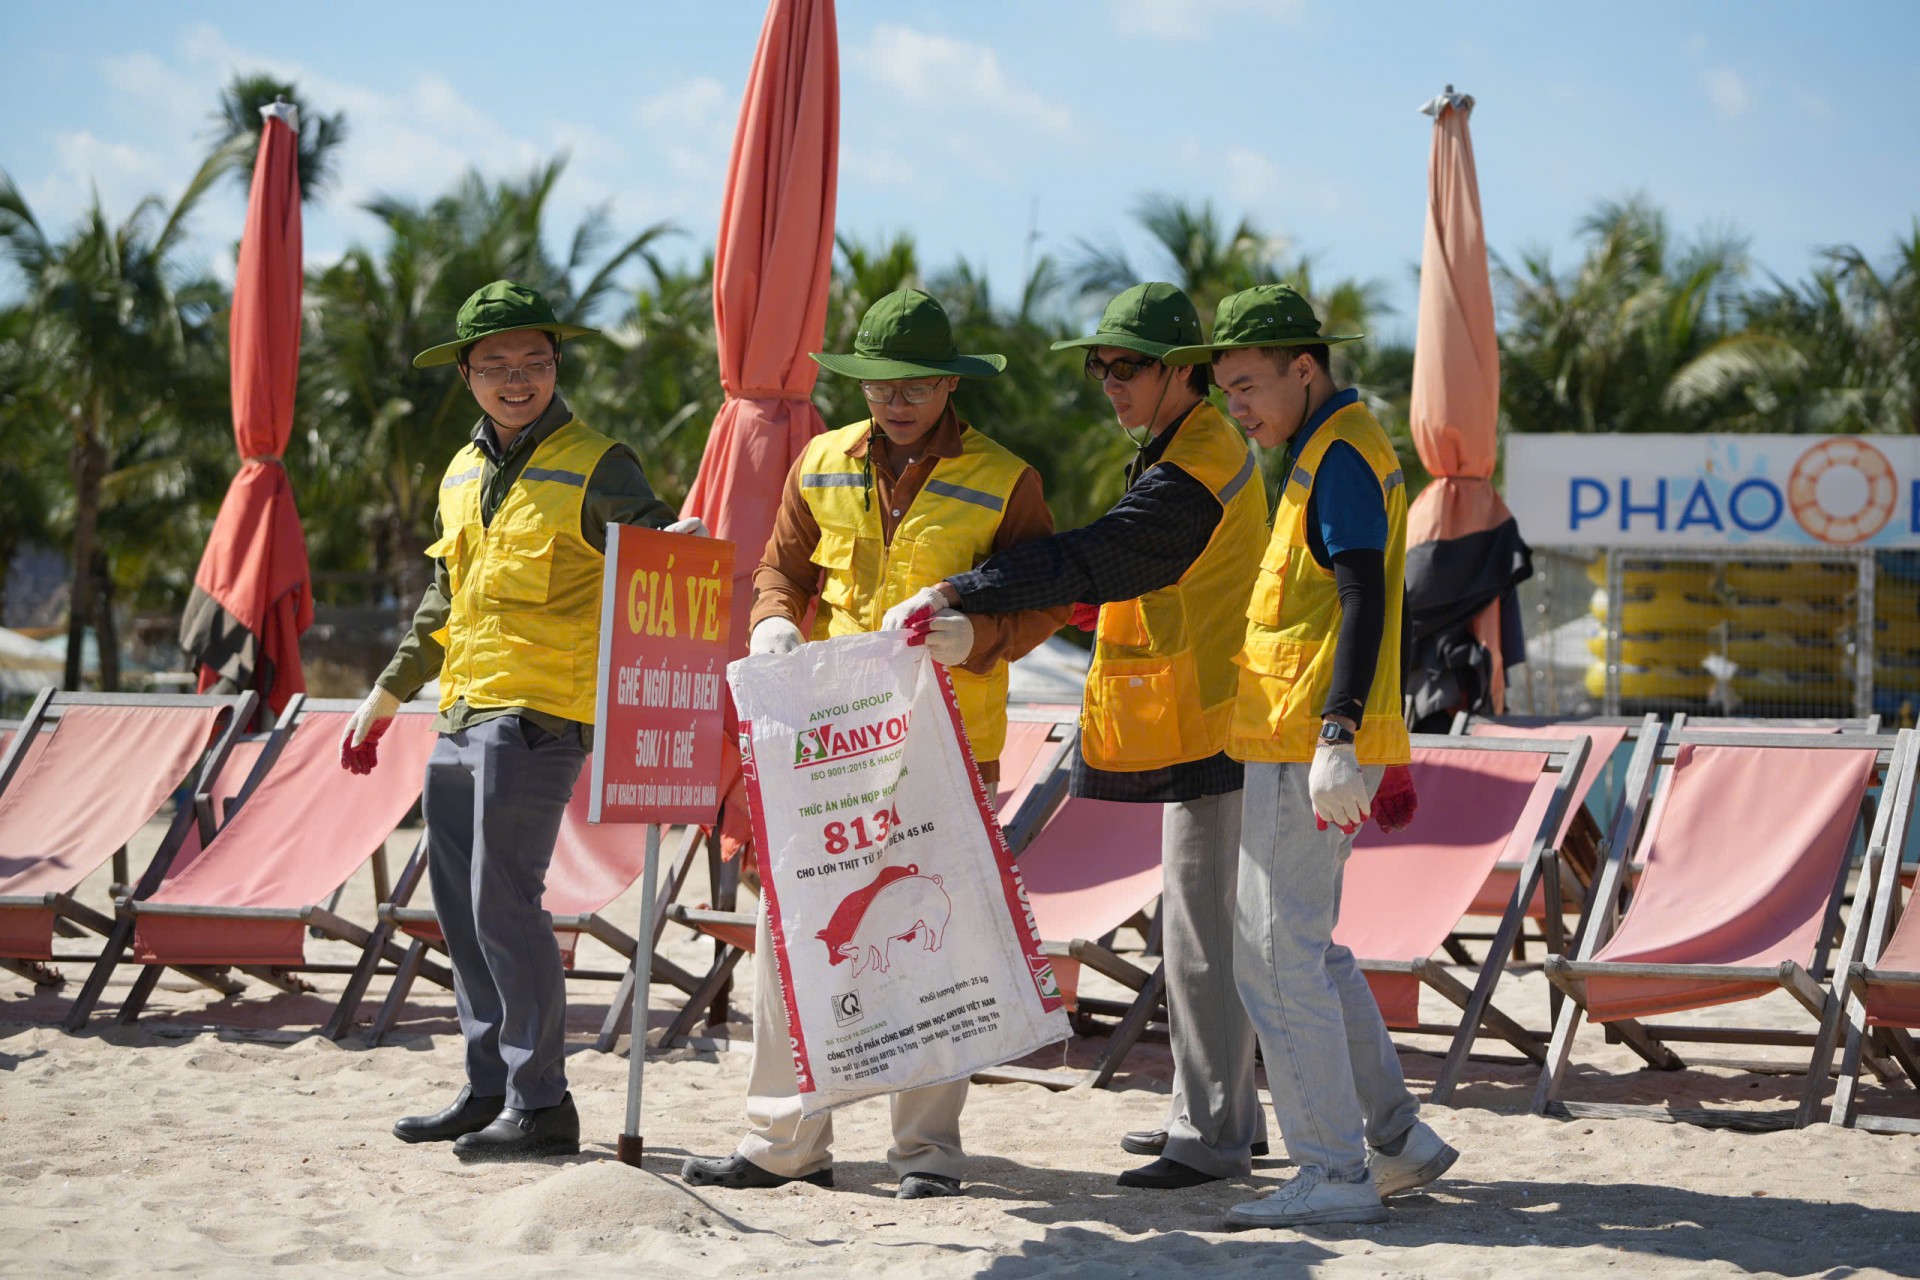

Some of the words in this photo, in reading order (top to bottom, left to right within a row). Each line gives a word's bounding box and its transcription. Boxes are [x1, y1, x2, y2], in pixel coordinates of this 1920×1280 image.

[1569, 477, 1785, 533] PHAO
[628, 553, 676, 638] GIÁ
[687, 560, 720, 641] VÉ
[618, 655, 643, 705] GHẾ
[642, 656, 671, 708] NGỒI
[672, 664, 692, 709] BÃI
[693, 658, 719, 710] BIỂN
[809, 704, 849, 722] ANYOU
[852, 691, 893, 711] GROUP
[636, 729, 662, 767] 50K/
[664, 731, 670, 768] 1
[673, 719, 696, 768] GHẾ
[811, 770, 825, 781] ISO
[828, 761, 868, 777] 9001:2015
[798, 802, 823, 818] THỨC
[825, 799, 838, 813] ĂN
[840, 792, 859, 809] HỖN
[861, 790, 880, 805] HỢP
[797, 868, 815, 879] CHO
[818, 863, 837, 876] LỢN
[838, 858, 860, 871] THỊT
[907, 827, 919, 838] 45
[921, 822, 934, 834] KG
[919, 992, 936, 1004] Khối
[936, 986, 955, 998] lượng
[971, 977, 979, 986] 25
[980, 976, 989, 984] kg
[827, 1051, 845, 1061] CÔNG
[846, 1047, 854, 1056] TY
[881, 1033, 898, 1045] CÔNG
[916, 1020, 932, 1031] SINH
[932, 1014, 946, 1025] HỌC
[946, 1006, 966, 1020] ANYOU
[981, 997, 996, 1007] NAM
